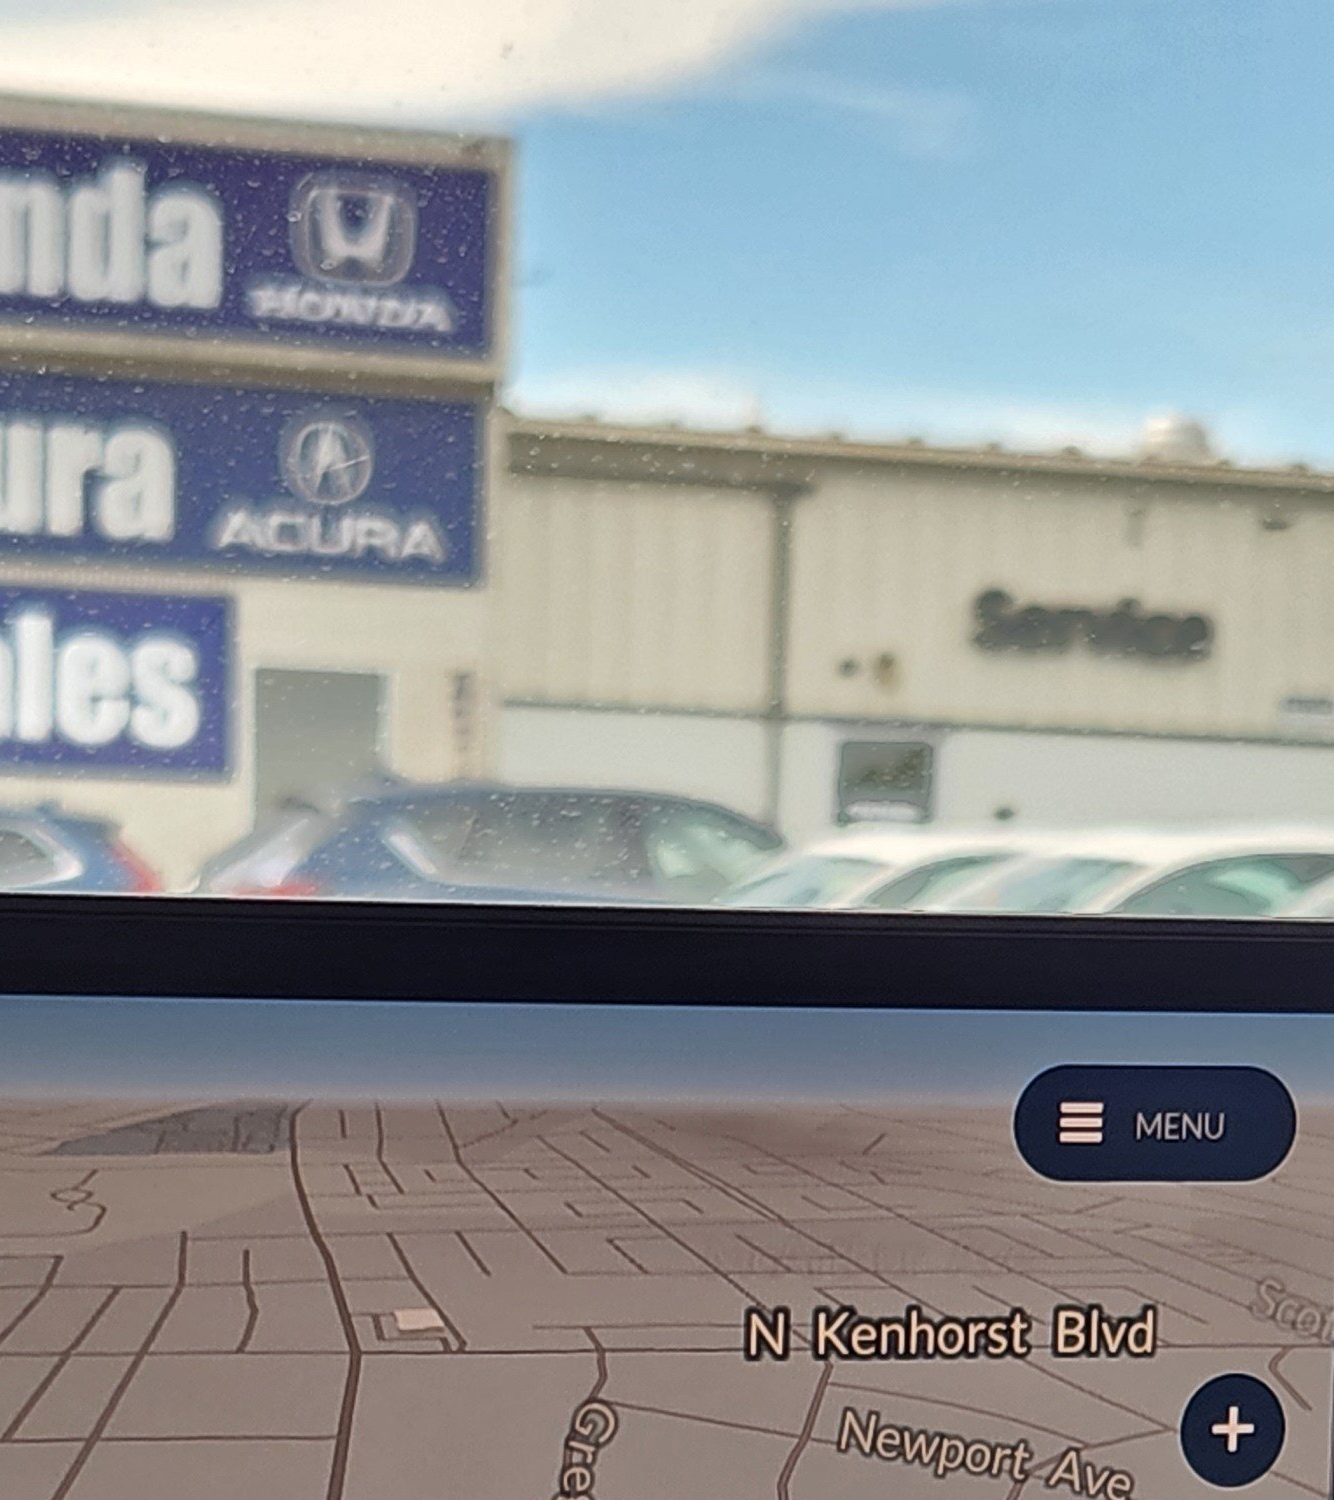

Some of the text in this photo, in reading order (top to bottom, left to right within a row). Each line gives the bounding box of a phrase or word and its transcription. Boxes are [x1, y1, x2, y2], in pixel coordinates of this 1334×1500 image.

[247, 283, 455, 333] HONDA
[214, 505, 446, 563] ACURA
[1134, 1111, 1225, 1141] MENU
[747, 1307, 1157, 1358] N Kenhorst Blvd
[837, 1407, 1030, 1482] Newport
